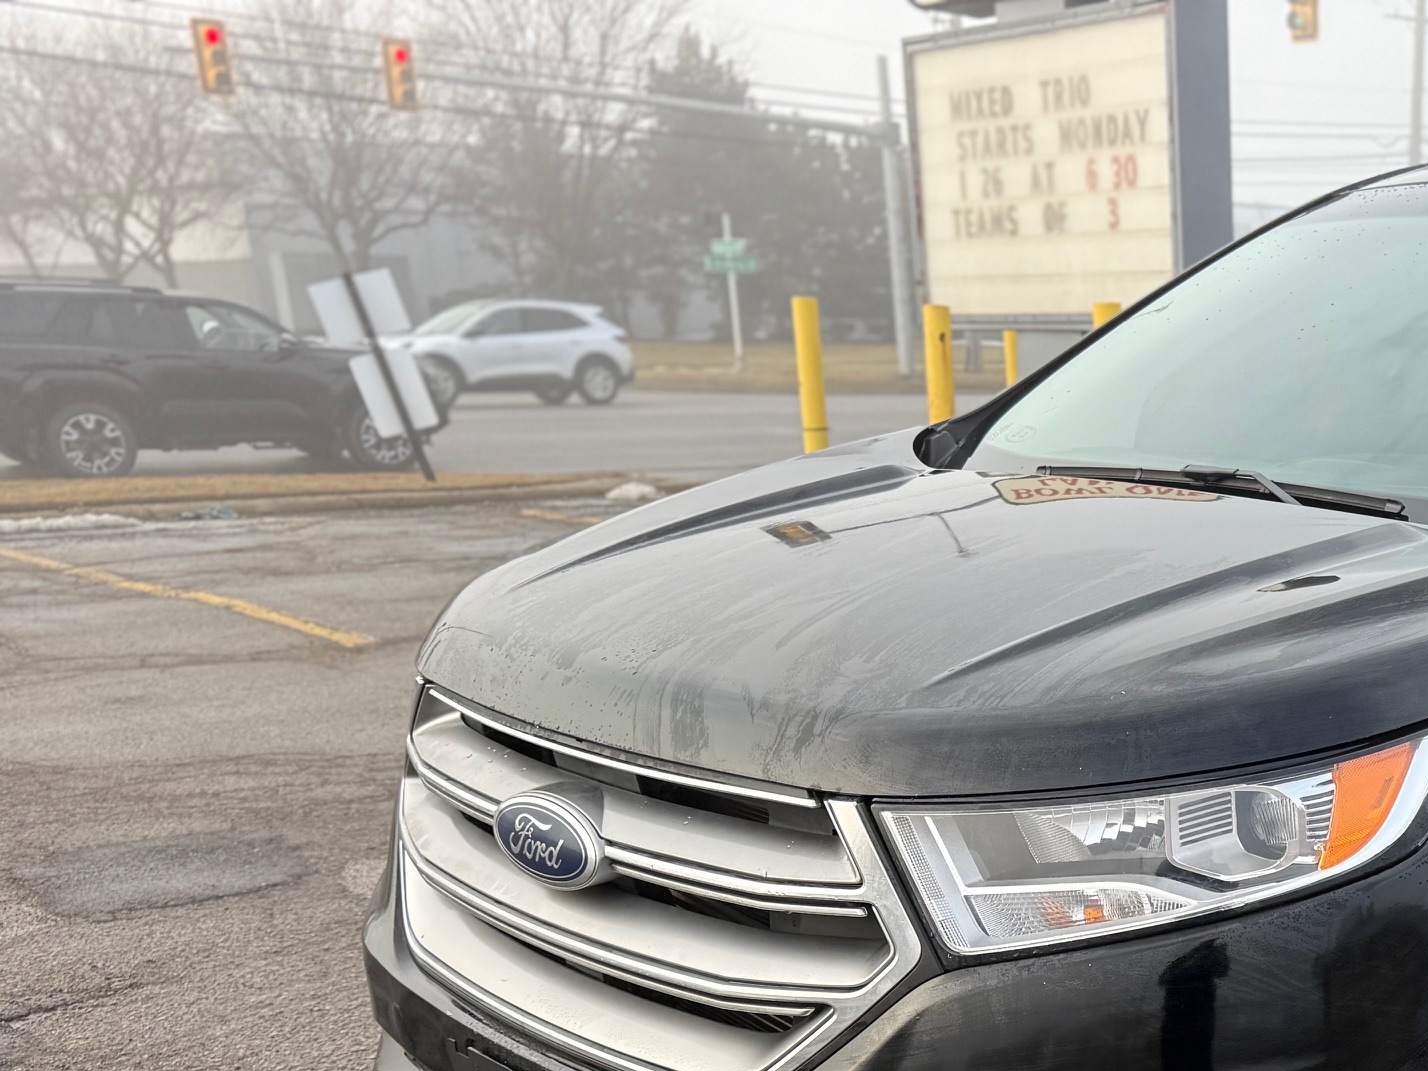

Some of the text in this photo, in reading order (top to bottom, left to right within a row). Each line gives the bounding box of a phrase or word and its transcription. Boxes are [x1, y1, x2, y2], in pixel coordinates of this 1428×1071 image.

[949, 74, 1091, 123] MIXED TRIO
[956, 108, 1150, 162] STARTS MONDAY
[981, 166, 1004, 198] 26
[1030, 161, 1056, 195] AT
[1111, 154, 1138, 190] 30
[952, 198, 1120, 240] TEAMS OF 3
[509, 813, 564, 869] Ford
